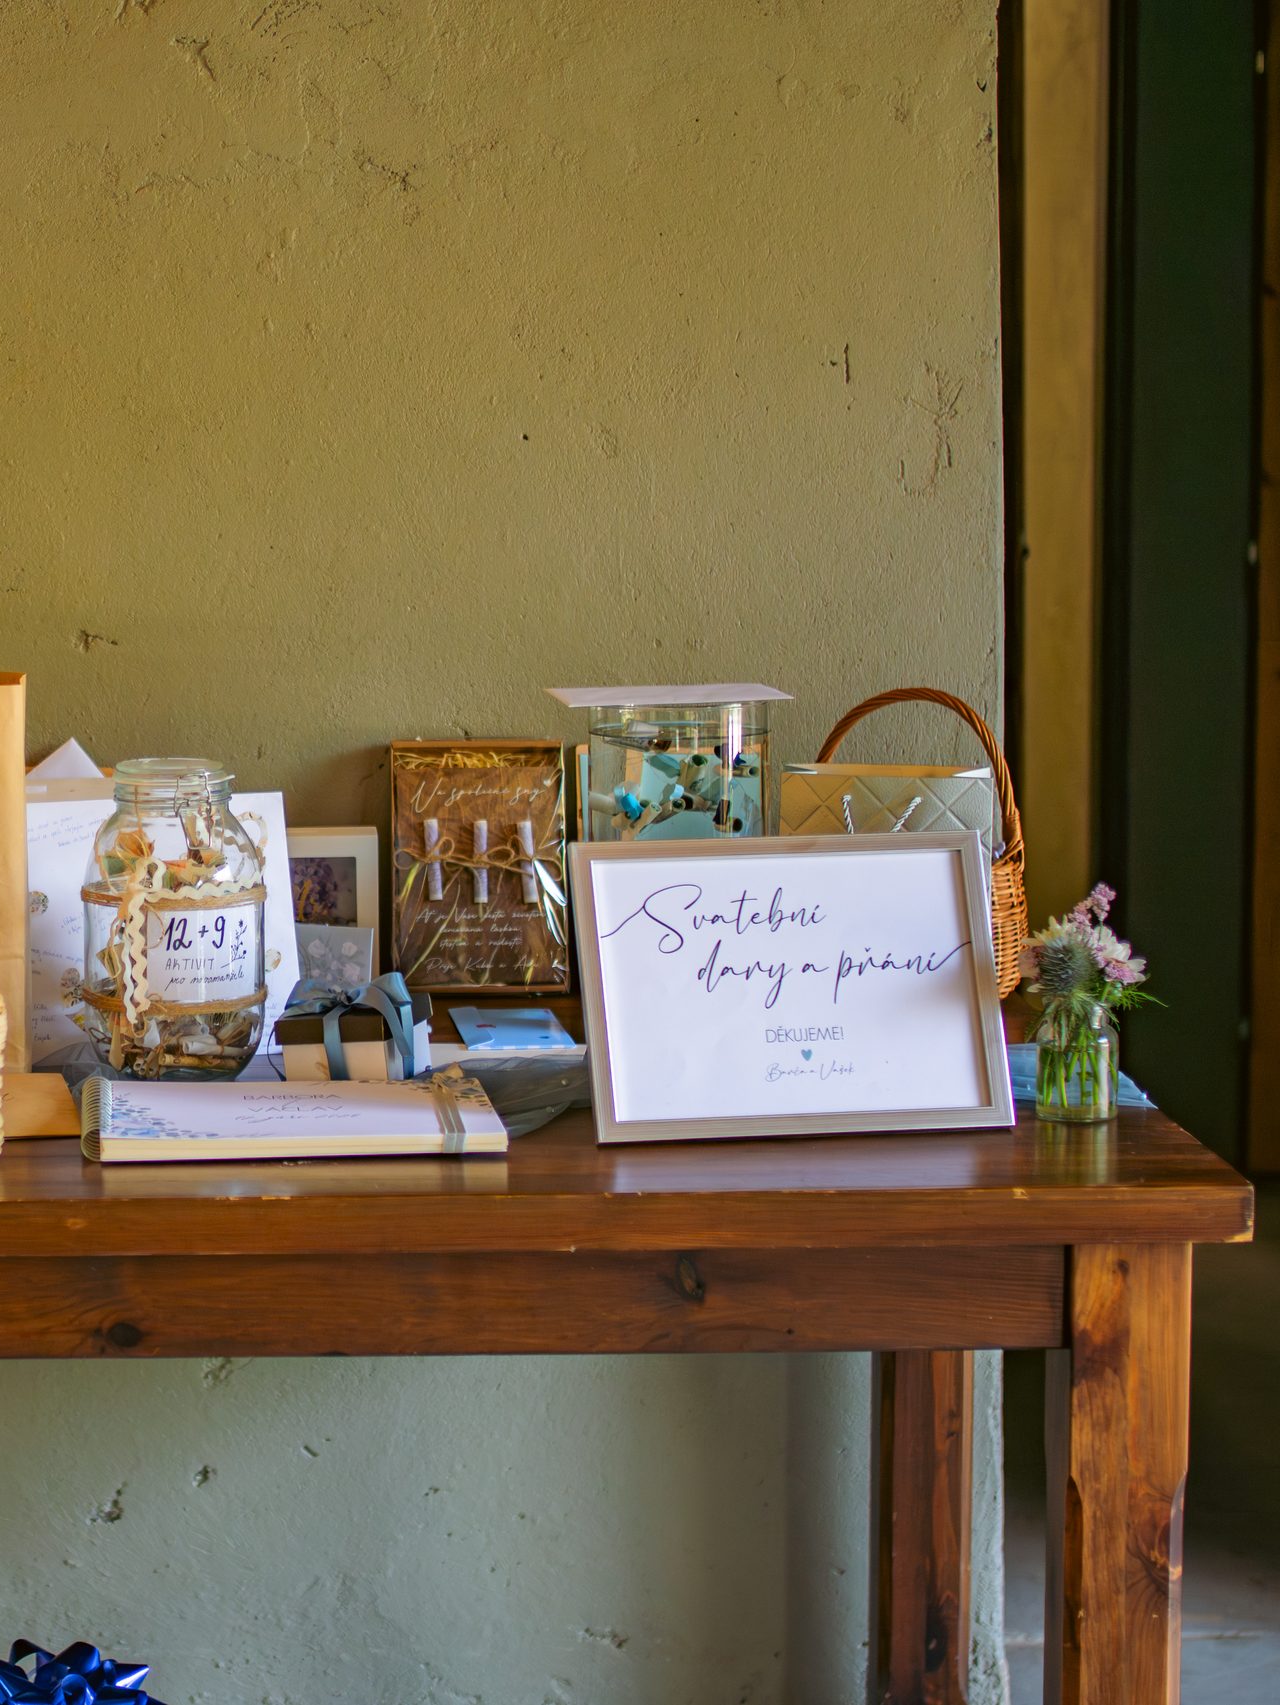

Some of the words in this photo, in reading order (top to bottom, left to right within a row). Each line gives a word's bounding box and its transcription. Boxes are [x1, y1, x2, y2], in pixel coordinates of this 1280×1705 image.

[164, 917, 193, 951] 12
[198, 925, 210, 938] +
[212, 915, 226, 949] 9
[600, 884, 826, 954] Svatební
[165, 958, 215, 971] AKTIVIT
[697, 939, 794, 1009] dary
[801, 963, 830, 975] a
[834, 941, 971, 1004] přání
[765, 1026, 845, 1043] DĚKUJEME!
